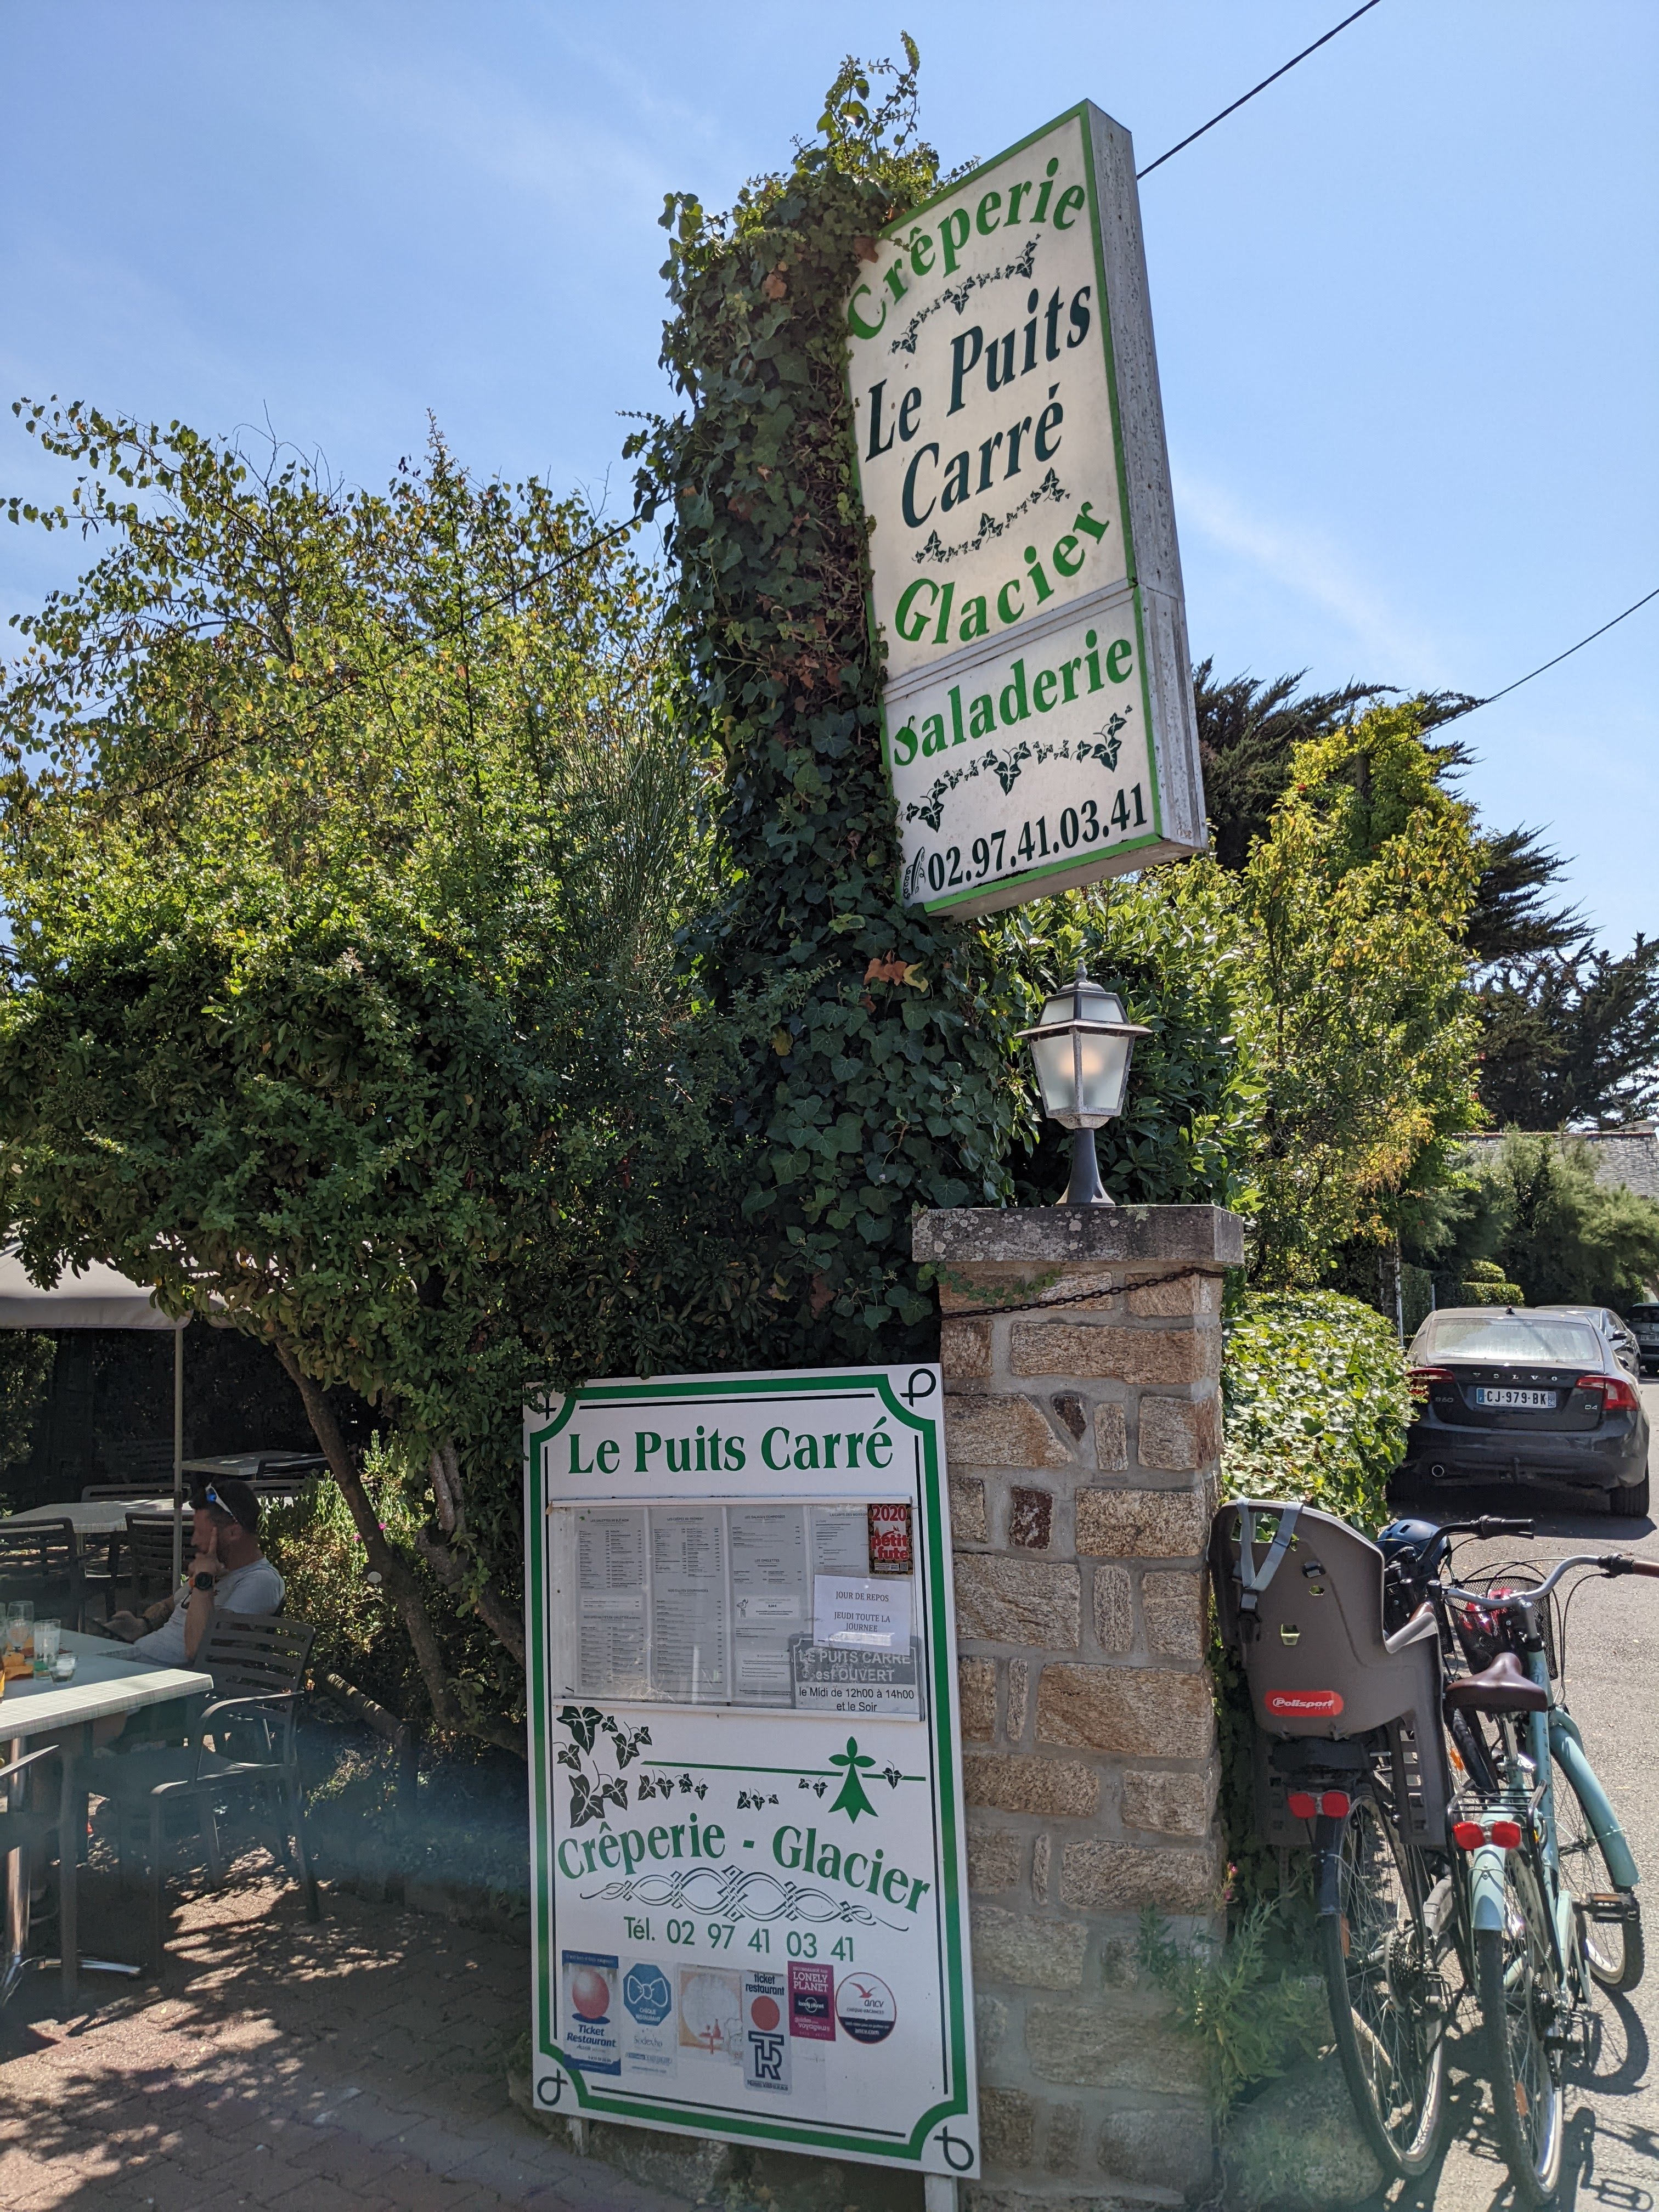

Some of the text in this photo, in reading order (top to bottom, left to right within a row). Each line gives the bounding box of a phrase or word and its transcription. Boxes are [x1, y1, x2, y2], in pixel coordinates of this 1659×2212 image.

[848, 157, 1086, 340] Crêperie
[865, 286, 1091, 463] Le Puits
[901, 382, 1063, 528] Carré
[895, 501, 1109, 645] Glacier
[894, 629, 1133, 766] Saladerie
[928, 783, 1147, 892] 02.97.41.03.41
[1472, 1373, 1558, 1381] VOLVO
[1486, 1391, 1547, 1405] CJ-979-BK
[568, 1416, 893, 1475] Le Puits Carré
[871, 1504, 907, 1522] 2020
[871, 1533, 909, 1550] petit
[836, 1591, 889, 1602] JOUR DE REPOS
[834, 1611, 854, 1620] JEUDI
[855, 1613, 879, 1622] TOUTE
[846, 1623, 878, 1632] JOURNEE
[820, 1649, 858, 1663] PUITS
[839, 1668, 895, 1681] OUVERT
[799, 1687, 807, 1696] le
[810, 1687, 828, 1697] Midi
[831, 1688, 843, 1697] de
[845, 1688, 874, 1698] 12h00
[877, 1688, 883, 1698] à
[885, 1689, 915, 1699] 14h00
[836, 1701, 878, 1712] et le Soir
[1272, 1697, 1334, 1708] Polisport
[558, 1813, 725, 1880] Crêperie
[772, 1824, 931, 1914] Glacier
[624, 1916, 854, 1962] Tél. 02 97 41 03 41
[754, 1973, 775, 1984] ticket
[793, 1971, 828, 1983] LONELY
[746, 1984, 785, 1995] restaurant
[793, 1981, 828, 1992] PLANET
[864, 1999, 884, 2008] ancv
[578, 2024, 605, 2036] Ticket
[566, 2032, 617, 2047] Restaurant
[634, 2035, 663, 2047] Sodexho
